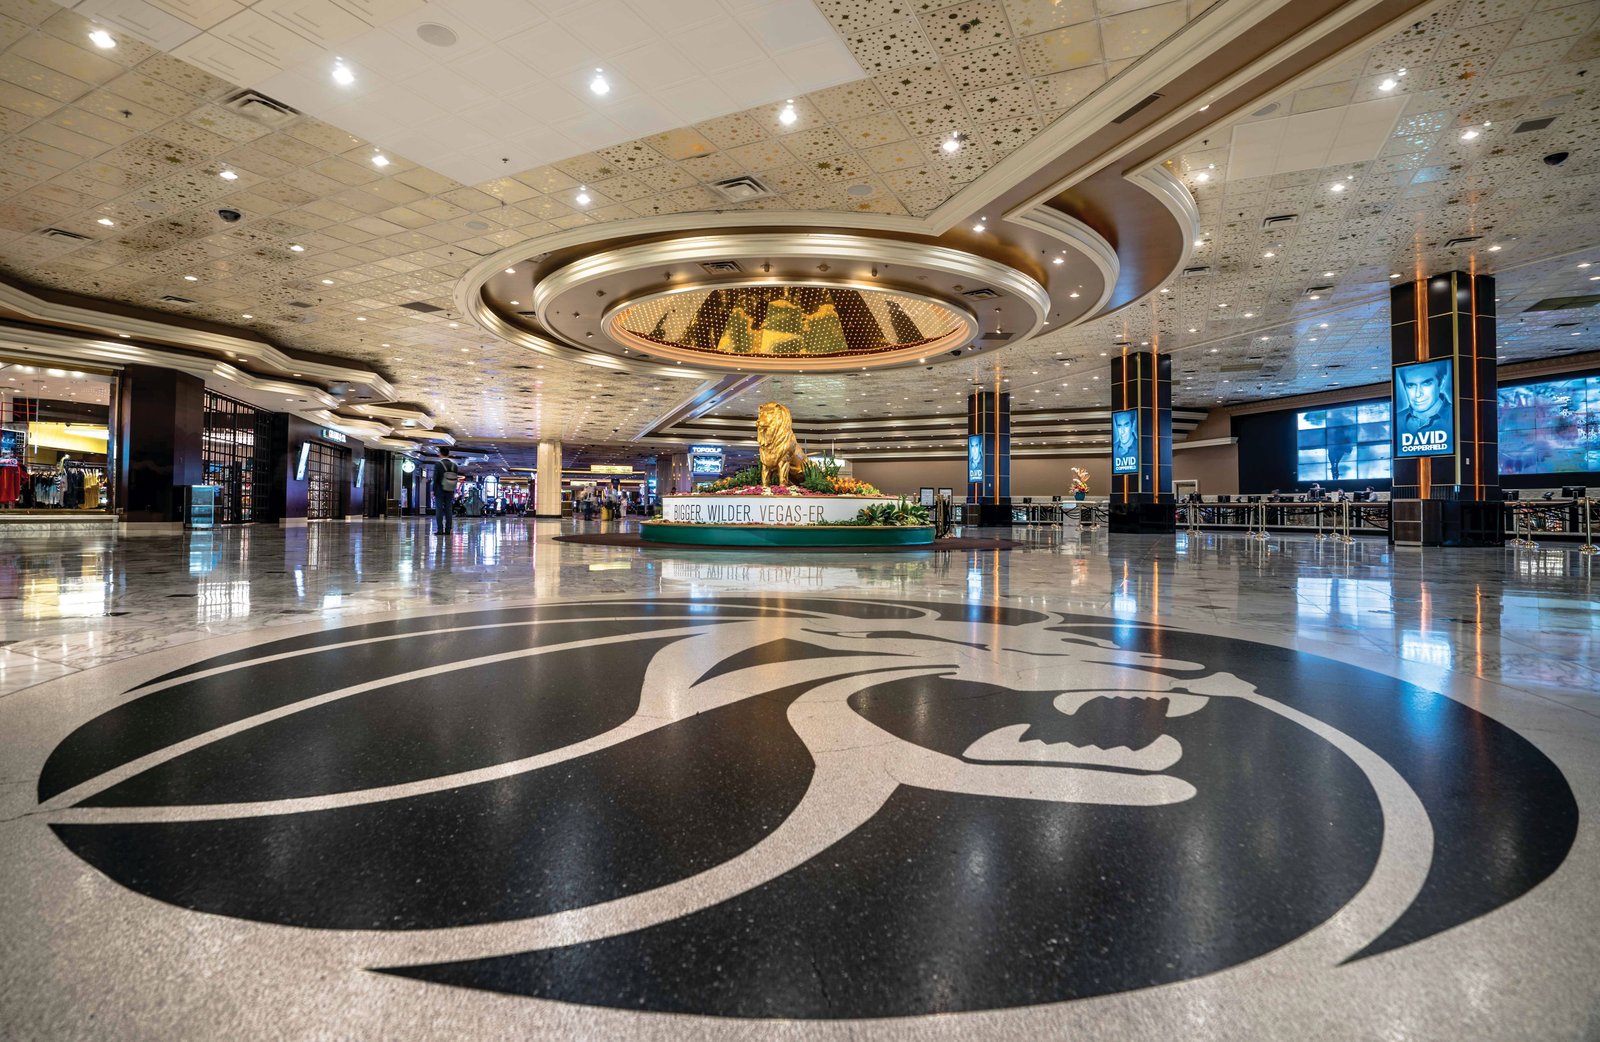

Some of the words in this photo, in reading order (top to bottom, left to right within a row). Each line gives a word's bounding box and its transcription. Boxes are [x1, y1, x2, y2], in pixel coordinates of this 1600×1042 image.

[1402, 430, 1447, 446] DAVID
[1402, 443, 1448, 452] COPPERFIELD
[1115, 456, 1136, 467] DAVID
[759, 504, 824, 523] VEGAS-ER
